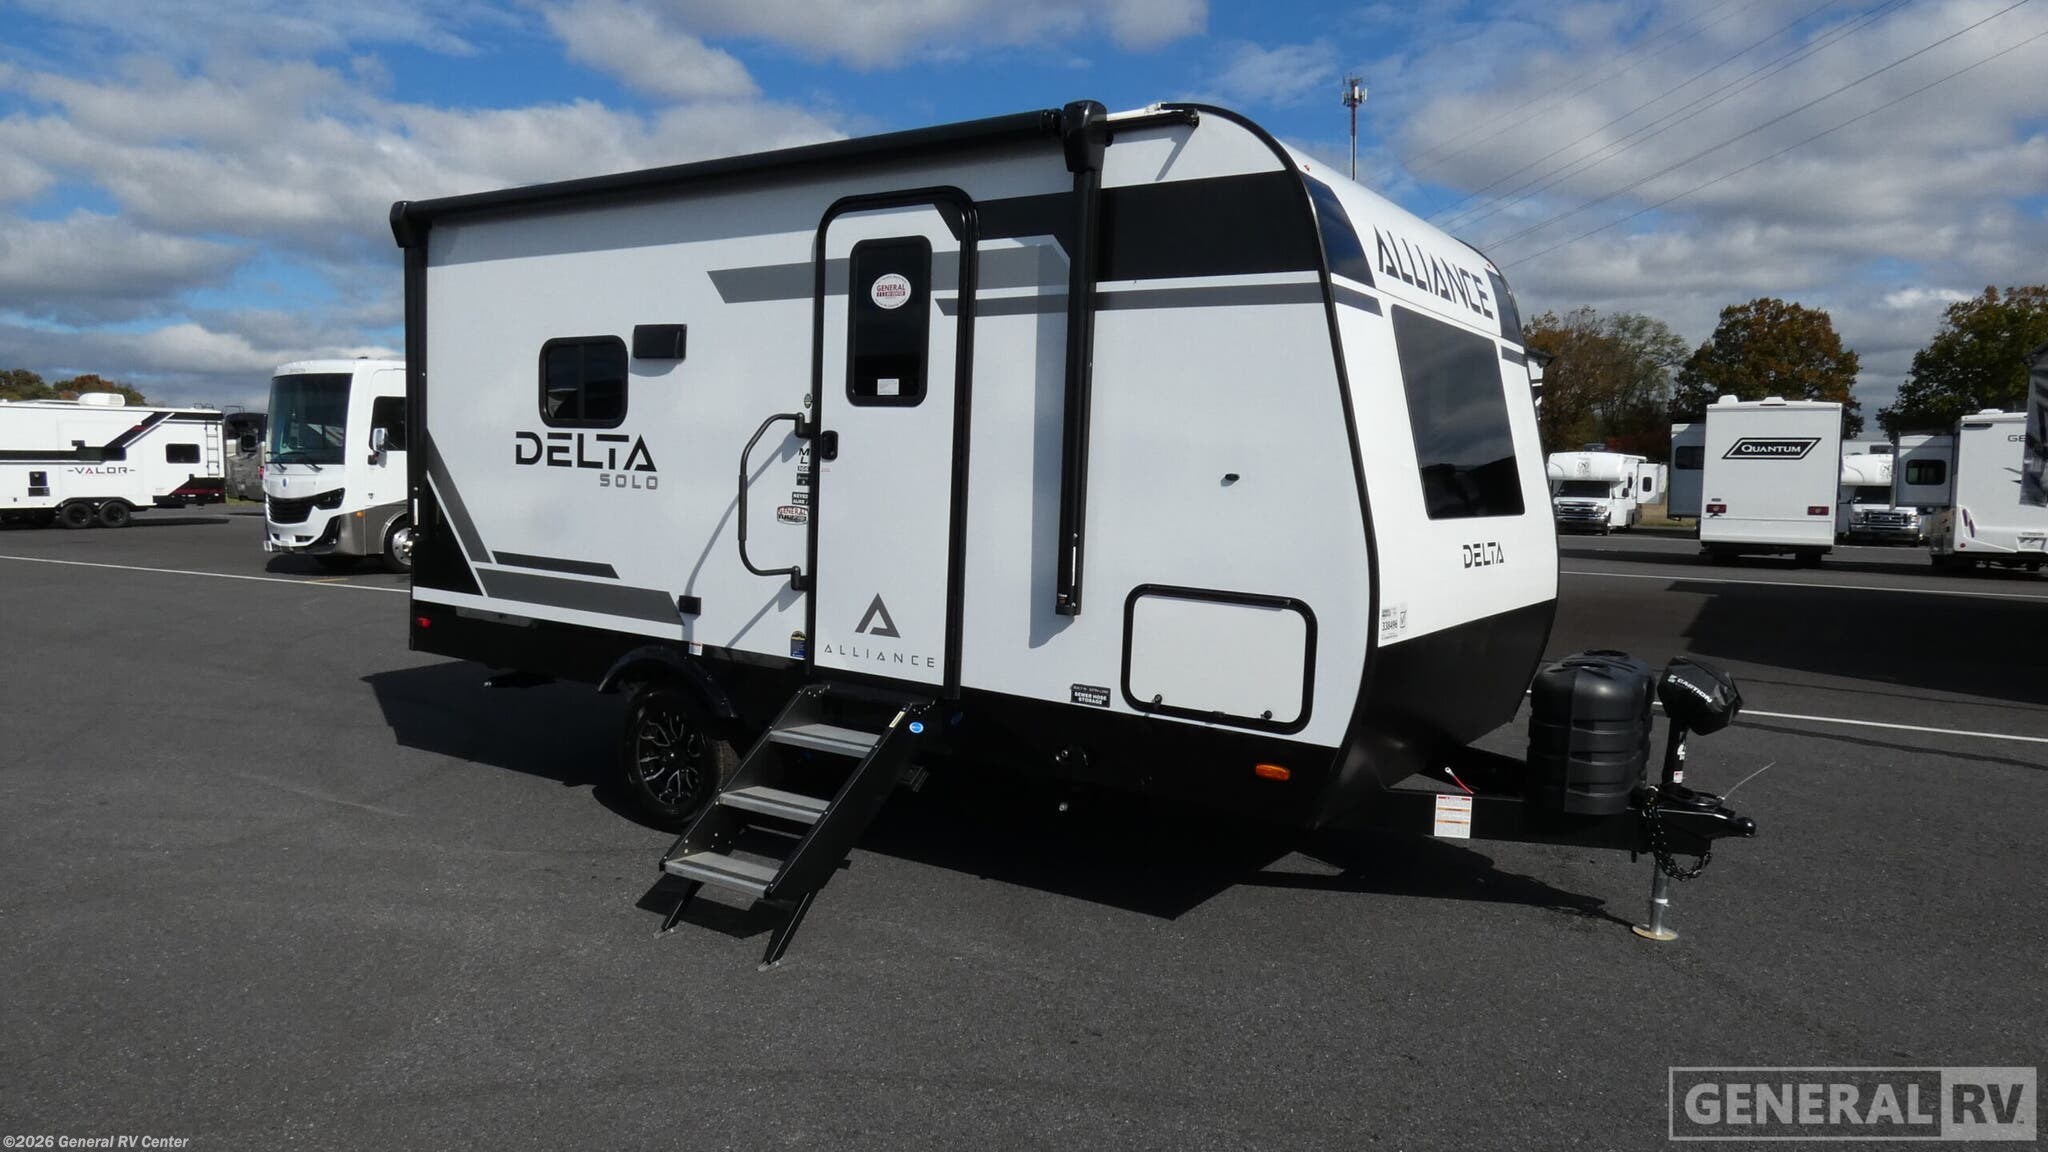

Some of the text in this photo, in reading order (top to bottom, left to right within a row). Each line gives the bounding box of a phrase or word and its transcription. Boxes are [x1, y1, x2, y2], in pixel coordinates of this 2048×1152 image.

[1373, 224, 1494, 320] ALLIANCE
[876, 284, 906, 292] GENERAL
[516, 431, 657, 472] DELTA
[1741, 444, 1801, 453] QUANTUM
[74, 466, 128, 474] VALOR
[600, 473, 658, 490] SOLO
[1463, 541, 1504, 568] DELTA
[824, 644, 935, 668] ALLIANCE
